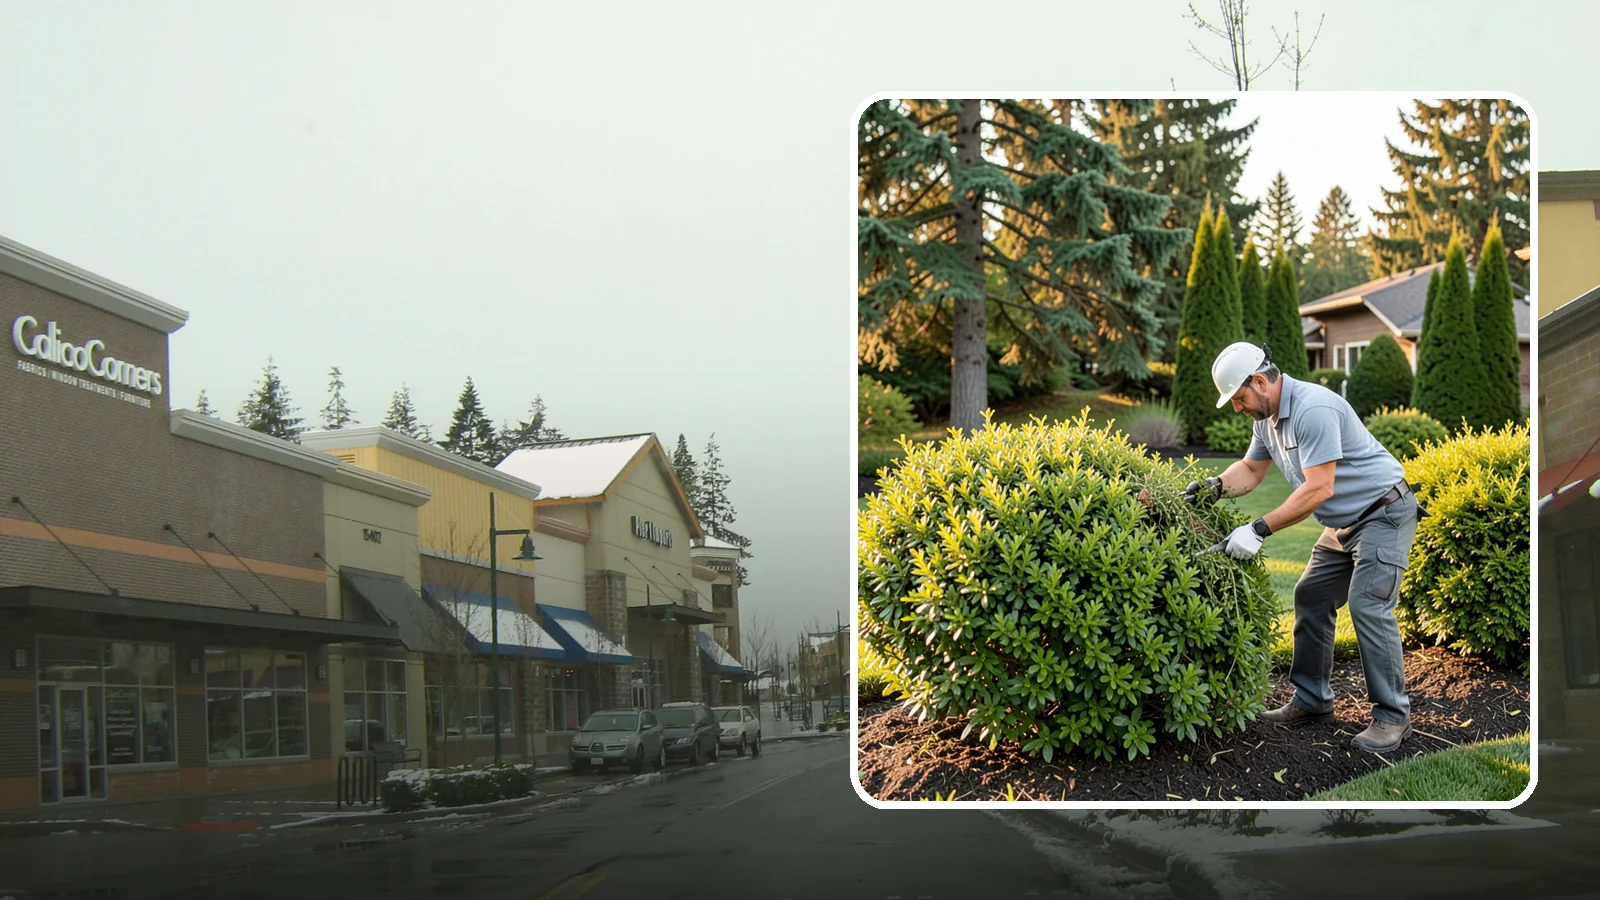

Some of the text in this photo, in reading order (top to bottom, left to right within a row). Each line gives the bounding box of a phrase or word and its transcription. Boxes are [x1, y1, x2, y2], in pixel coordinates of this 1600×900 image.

[17, 360, 152, 409] FABRICS WINDOW TREATMENTS FURNITURE
